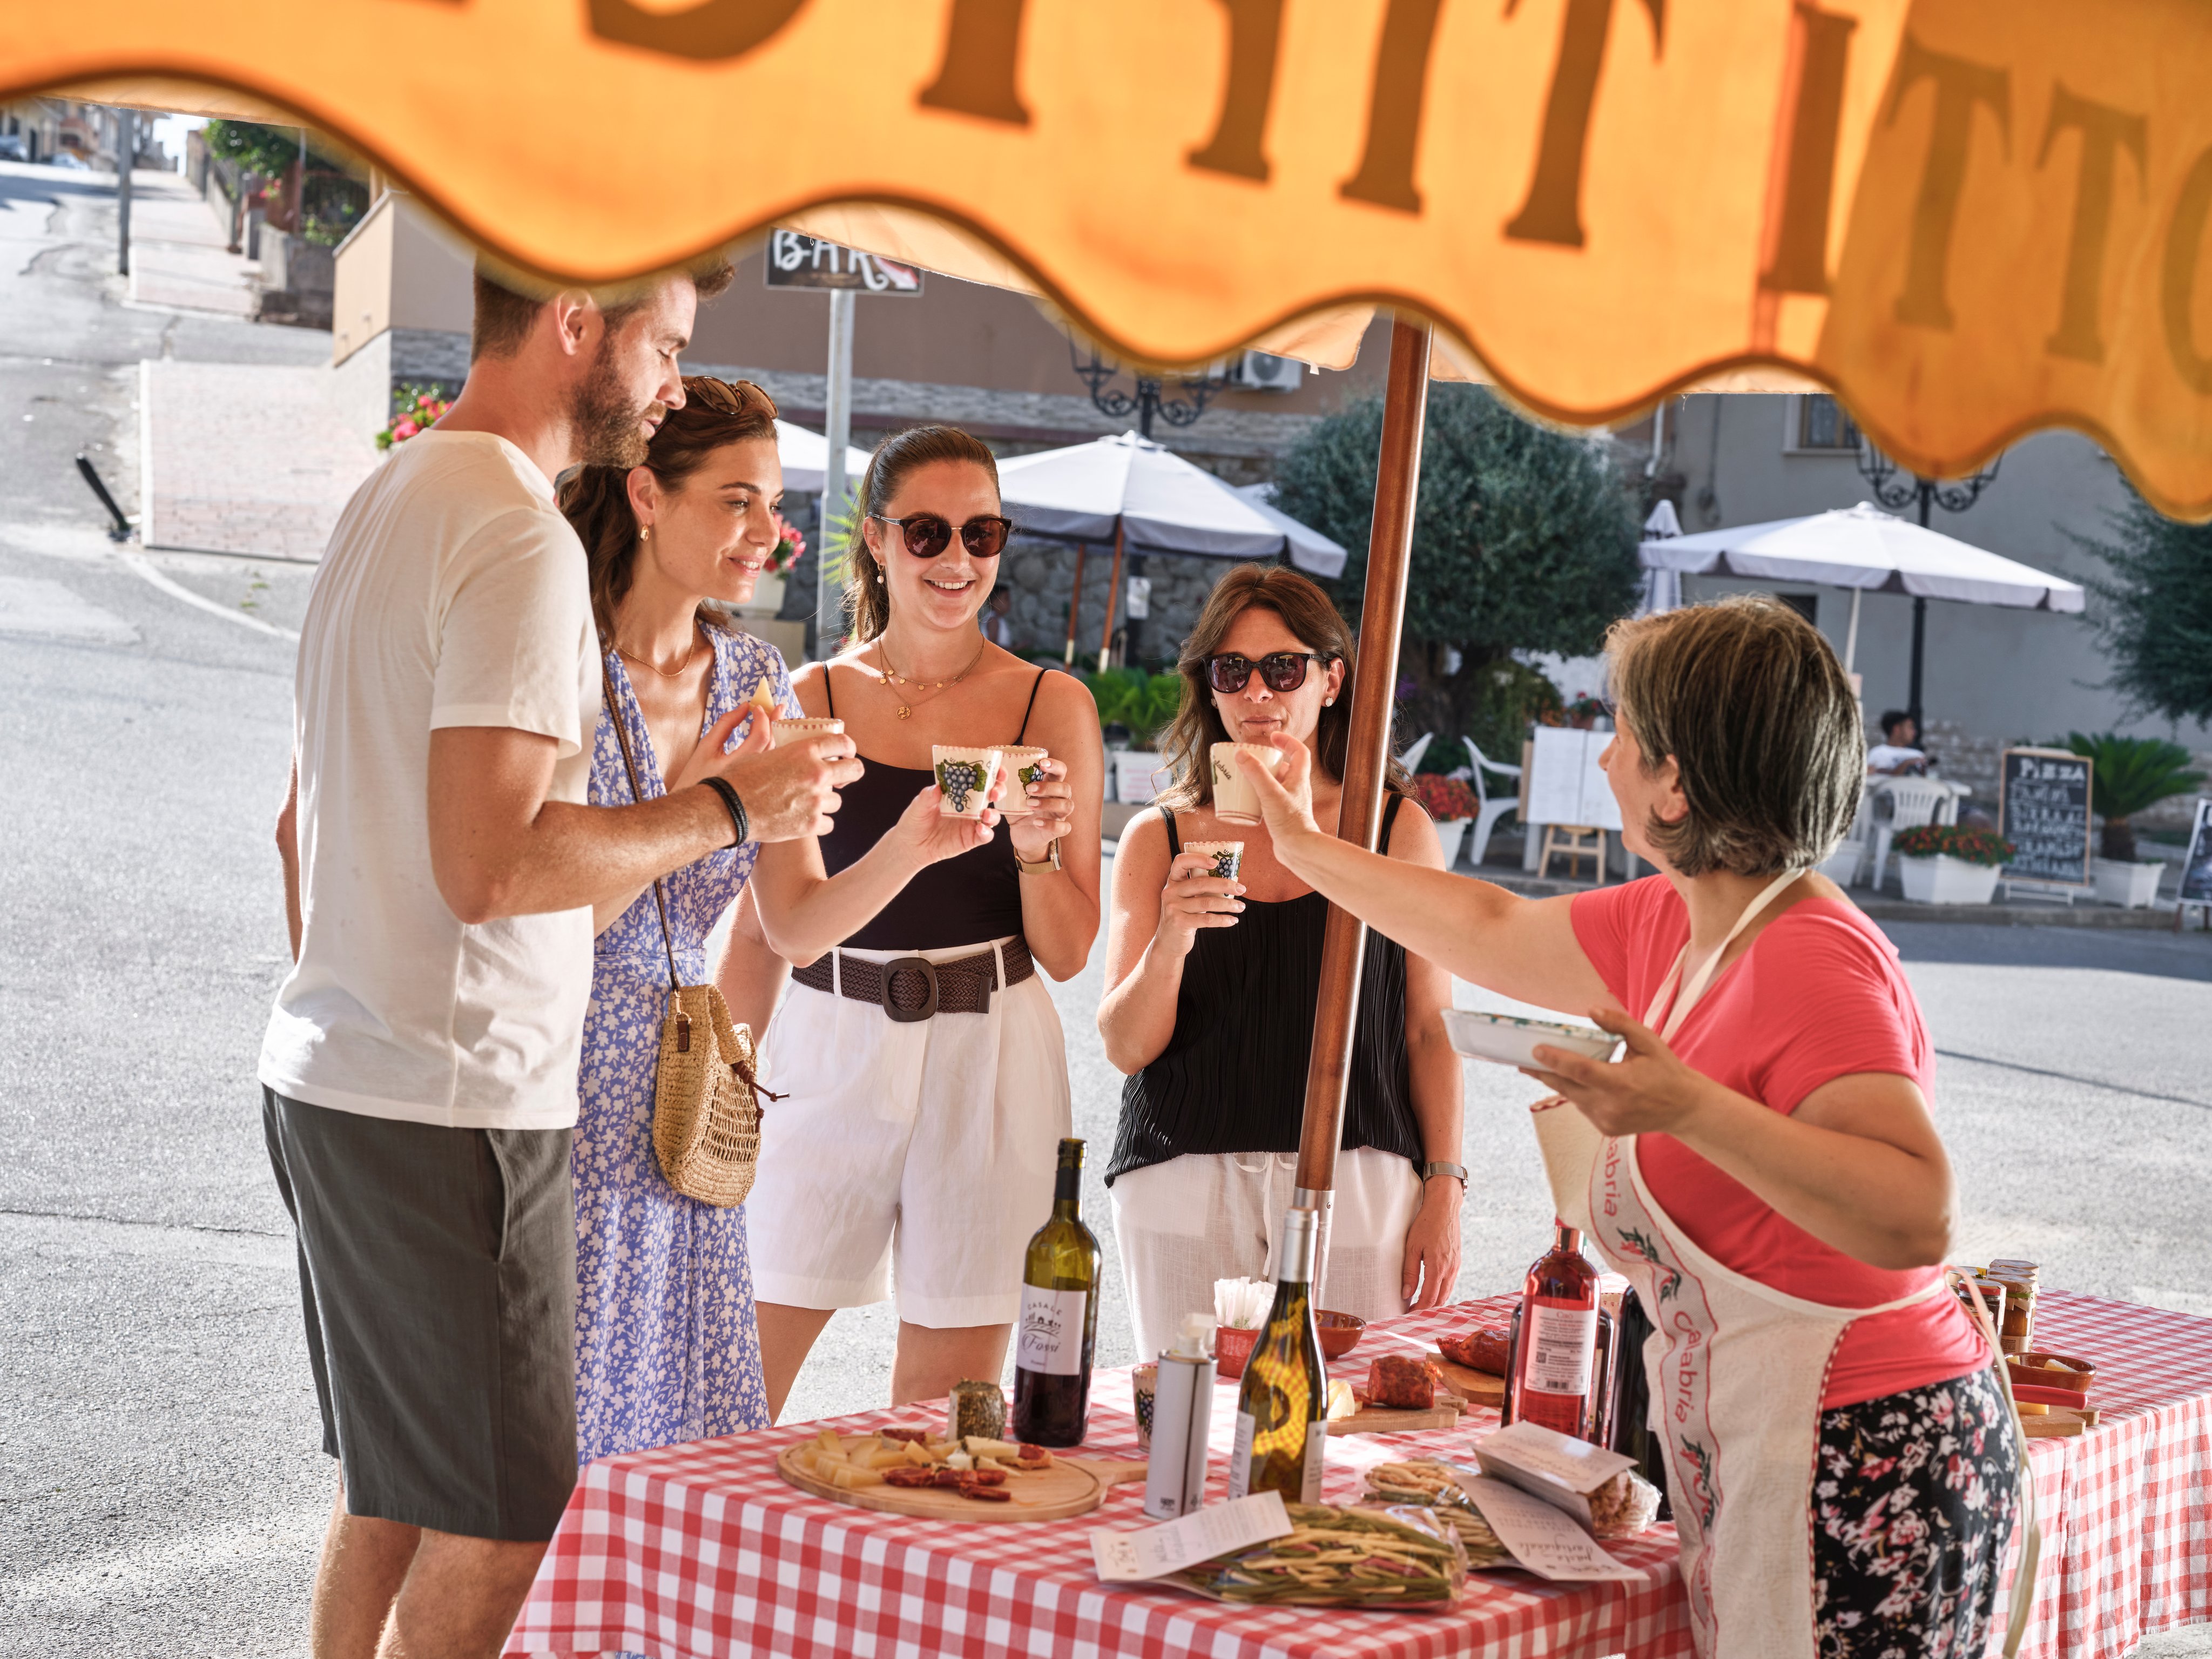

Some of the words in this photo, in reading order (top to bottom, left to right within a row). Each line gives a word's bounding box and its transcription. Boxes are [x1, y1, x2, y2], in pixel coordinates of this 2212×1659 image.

[773, 228, 889, 291] BAR
[2019, 757, 2086, 780] PIZZA
[1028, 1301, 1062, 1316] CASALE
[1022, 1333, 1062, 1354] Fossi
[1674, 1310, 1702, 1424] Calabria
